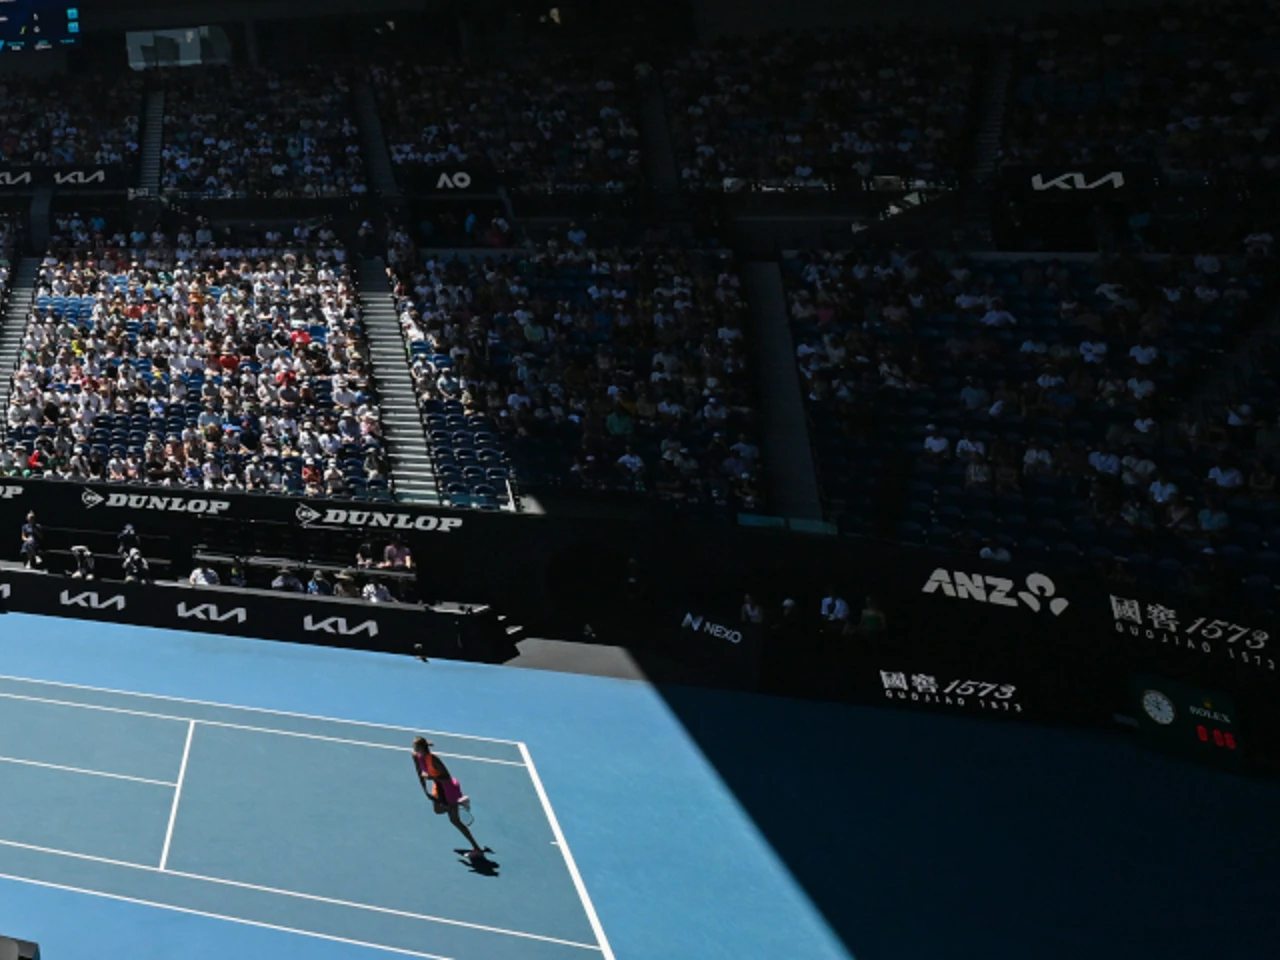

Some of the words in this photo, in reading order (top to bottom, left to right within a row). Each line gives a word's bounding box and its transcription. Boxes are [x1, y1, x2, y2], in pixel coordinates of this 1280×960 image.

[54, 170, 105, 184] KIA
[437, 172, 470, 188] AO
[1032, 172, 1124, 190] KIA
[105, 492, 230, 515] DUNLOP
[320, 508, 463, 532] DUNLOP
[922, 568, 1019, 607] ANZ
[60, 590, 125, 610] KIA
[177, 602, 246, 622] KIA
[304, 615, 378, 636] KIA
[703, 621, 743, 644] NEXO
[1189, 704, 1232, 724] ROLEX
